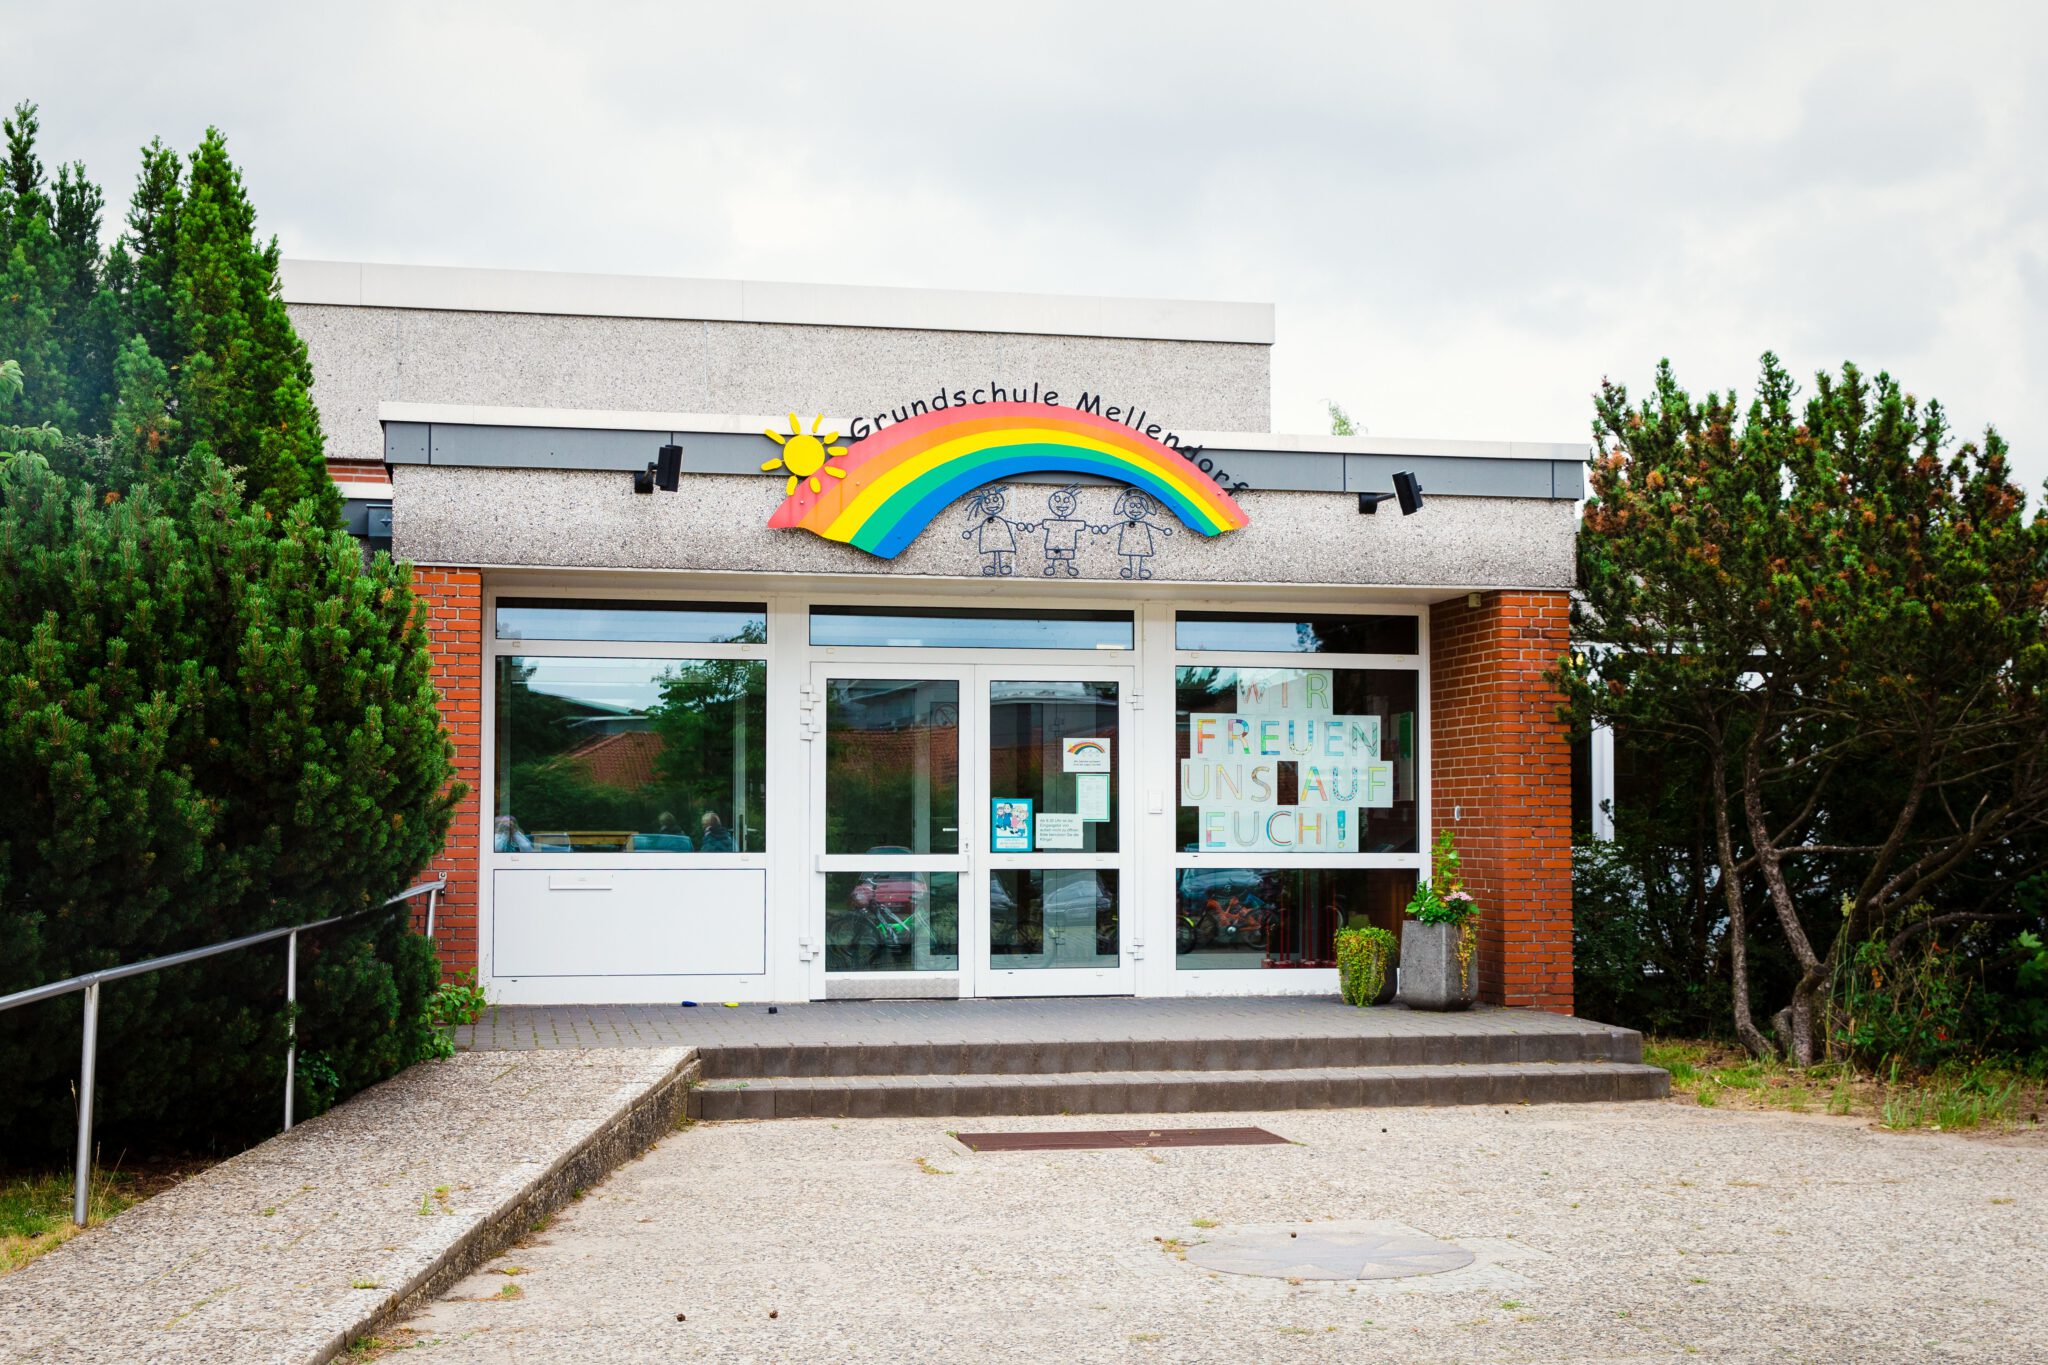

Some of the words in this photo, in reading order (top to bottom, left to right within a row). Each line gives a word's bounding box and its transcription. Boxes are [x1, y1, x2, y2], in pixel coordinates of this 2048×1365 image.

[850, 381, 1059, 441] Grundschule
[1076, 391, 1249, 496] Mellendorf
[1239, 671, 1329, 709] WIR
[1197, 718, 1378, 757] FREUEN
[1183, 764, 1272, 802] UNS
[1299, 765, 1388, 803] AUF
[1205, 809, 1346, 848] EUCH!
